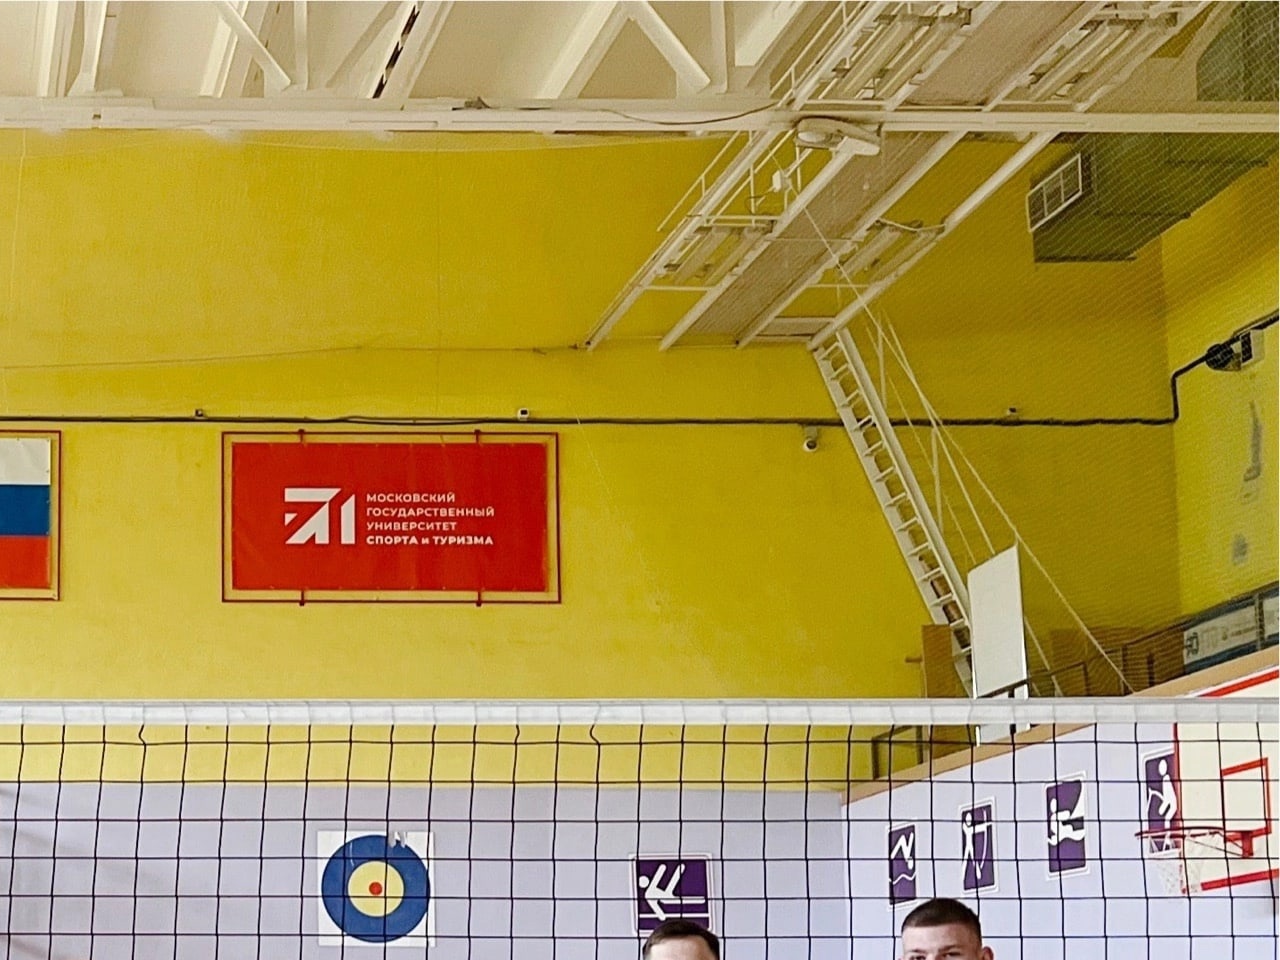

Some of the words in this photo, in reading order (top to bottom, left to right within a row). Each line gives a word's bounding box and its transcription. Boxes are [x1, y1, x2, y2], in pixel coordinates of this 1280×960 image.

[365, 491, 456, 503] МОСКОВСКИЙ
[365, 506, 495, 518] ГОСУДАРСТВЕННЫЙ
[365, 521, 457, 531] УНИВЕРСИТЕТ
[365, 535, 419, 545] СПОРТА
[432, 535, 494, 545] ТУРИЗМА
